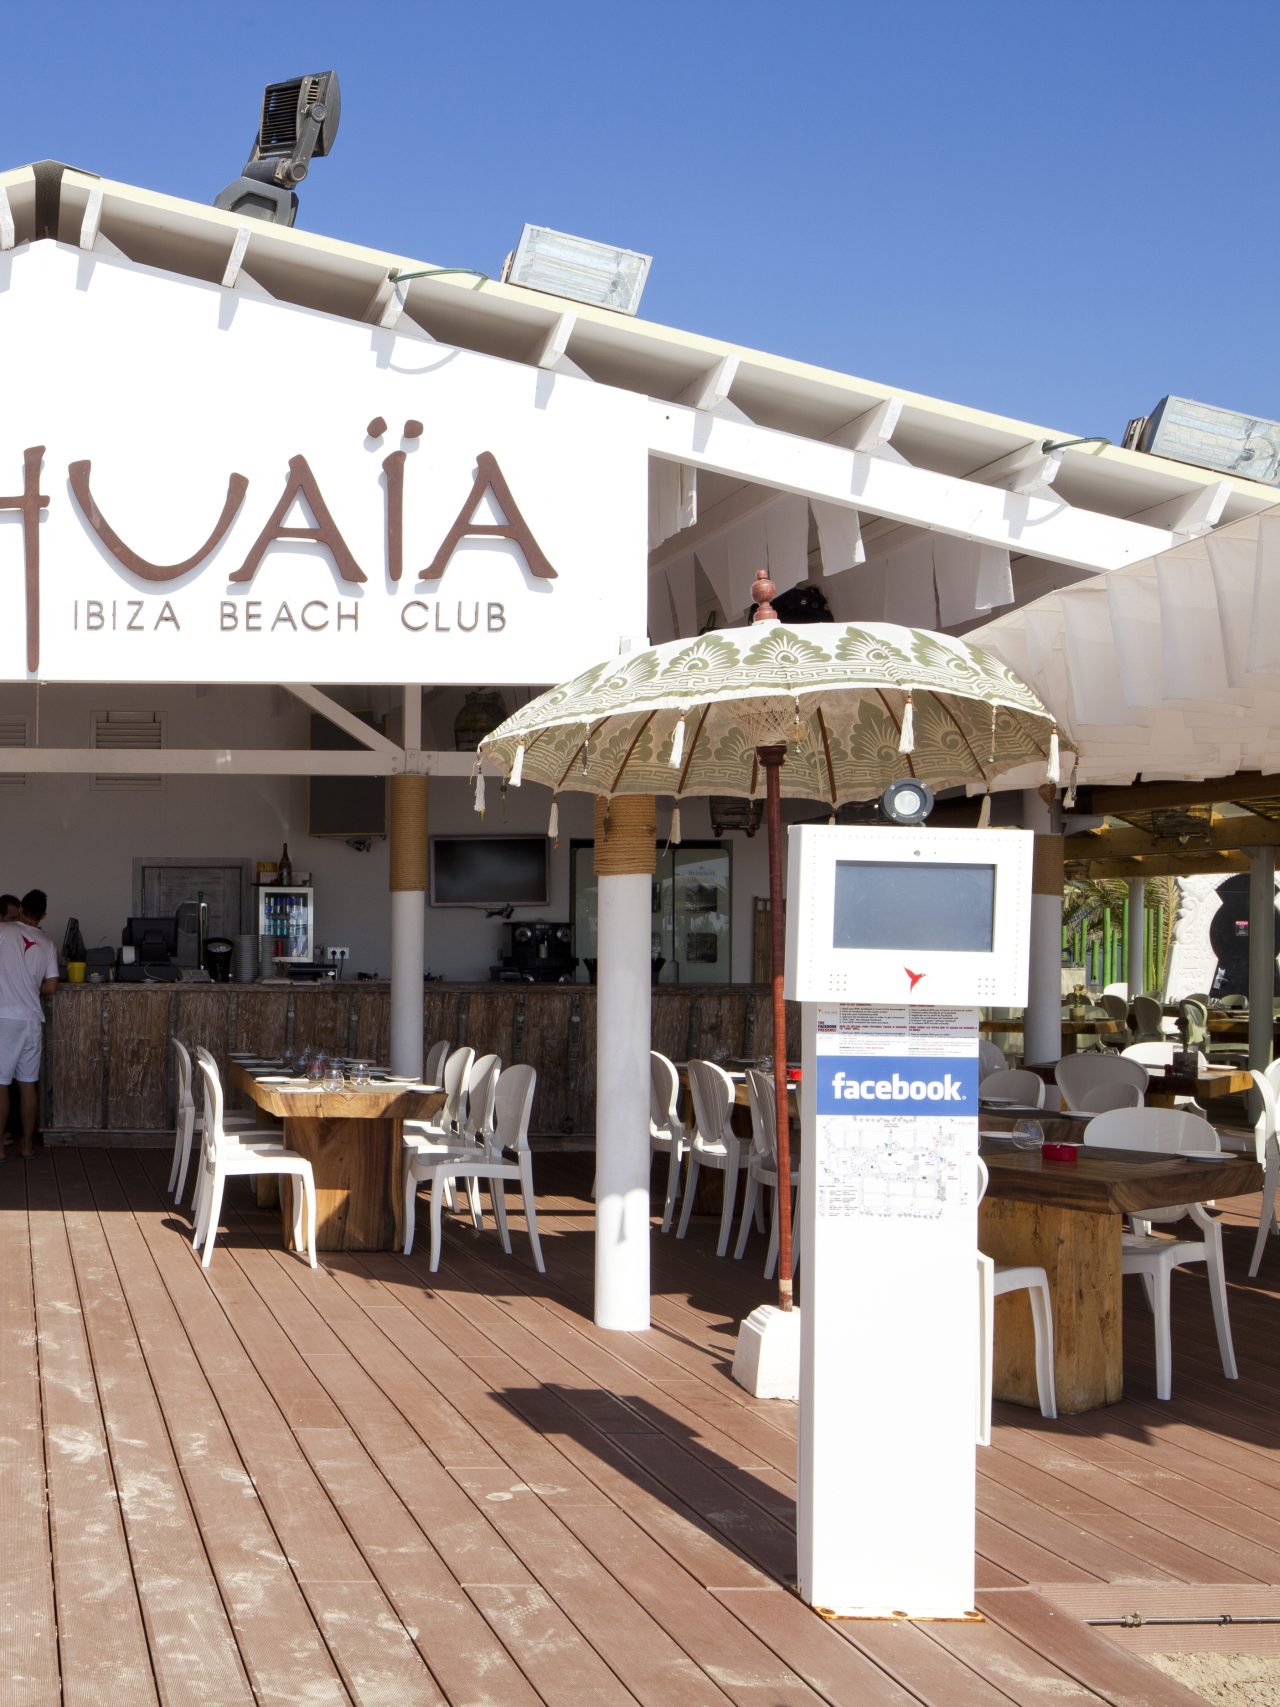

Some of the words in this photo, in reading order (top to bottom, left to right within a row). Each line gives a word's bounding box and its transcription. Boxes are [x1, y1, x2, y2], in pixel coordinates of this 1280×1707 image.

[75, 601, 181, 631] IBIZA
[221, 601, 358, 631] BEACH
[401, 601, 506, 631] CLUB
